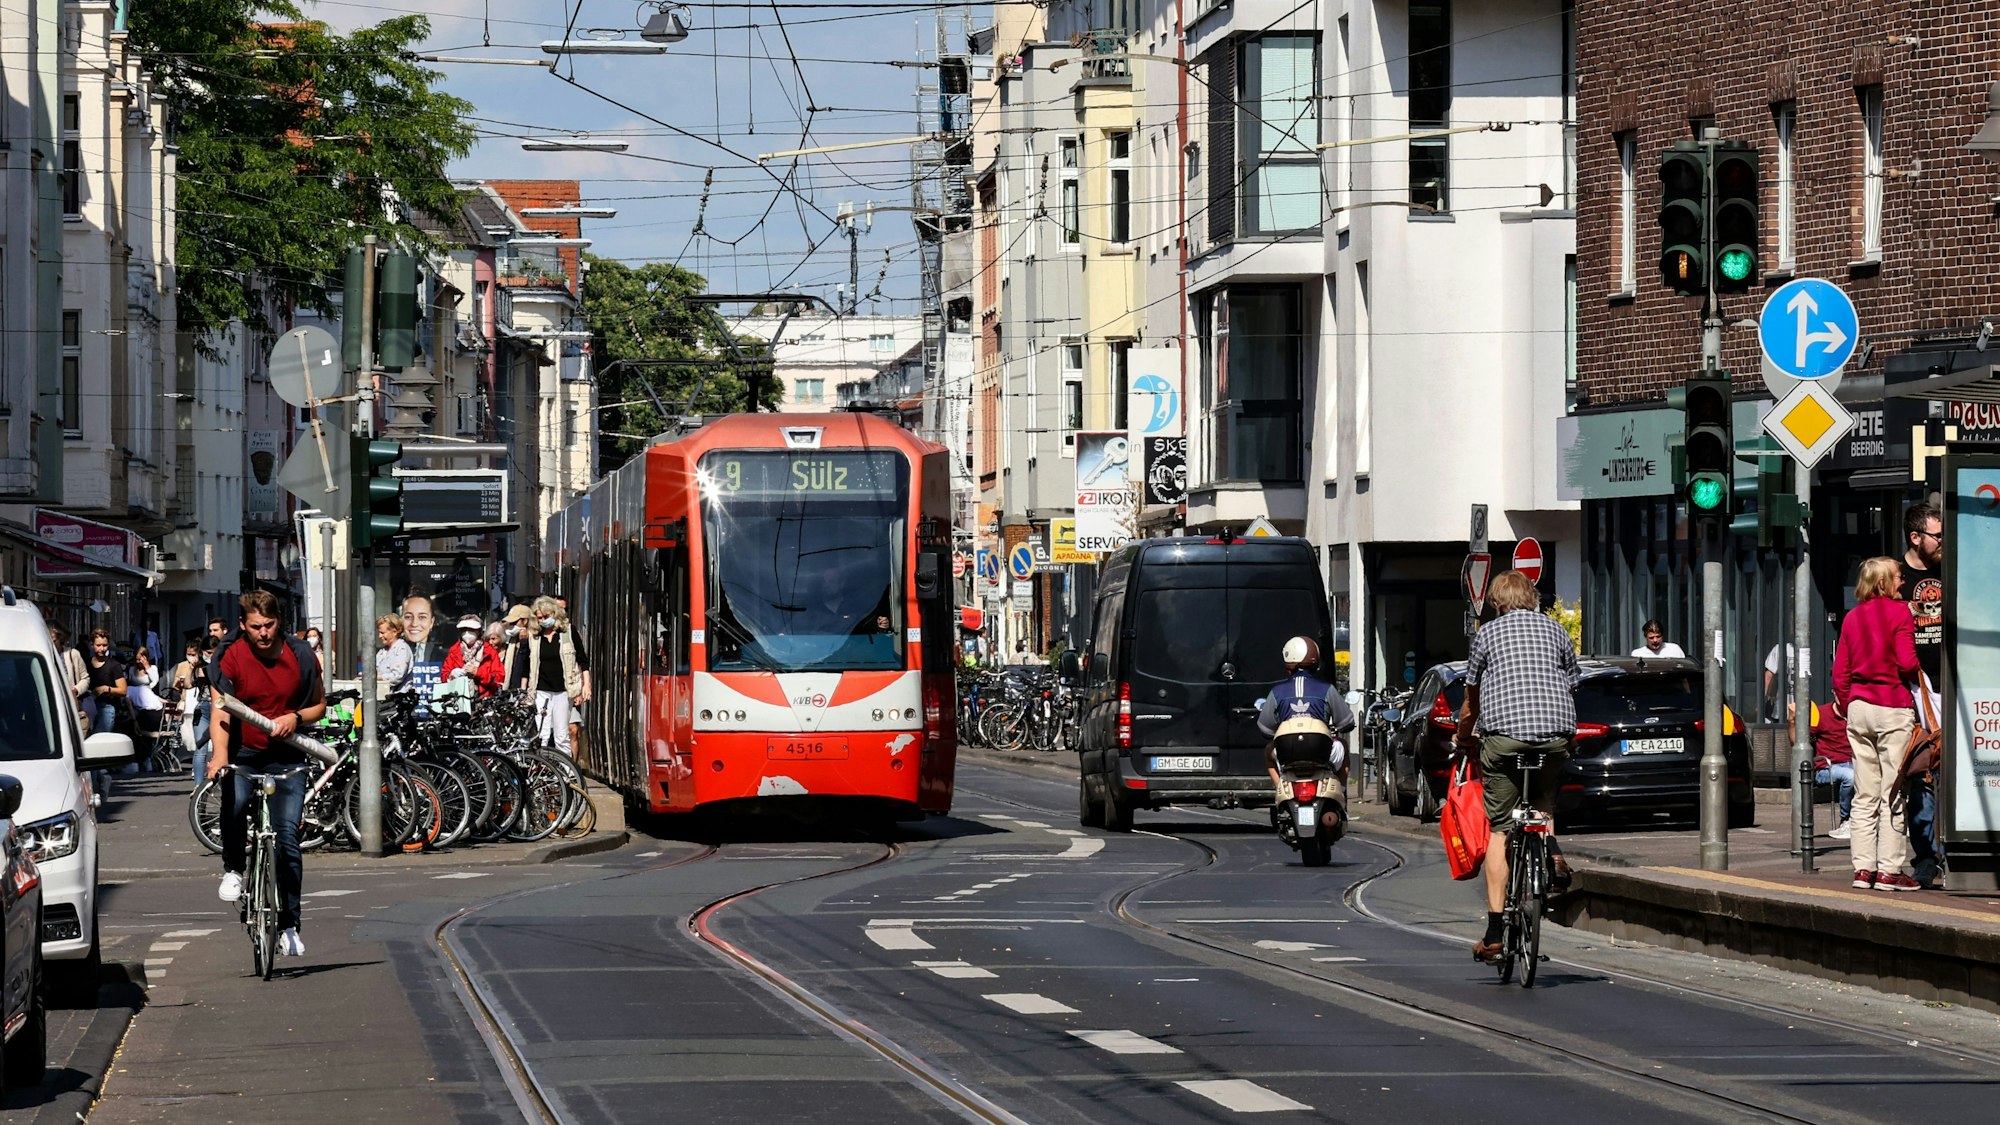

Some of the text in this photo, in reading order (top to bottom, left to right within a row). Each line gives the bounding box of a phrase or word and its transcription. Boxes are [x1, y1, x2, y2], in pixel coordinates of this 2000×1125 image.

[1851, 410, 1884, 437] PETE
[1153, 438, 1186, 452] SKE
[1850, 440, 1885, 457] BEERDIG
[726, 460, 849, 491] 9 Sülz
[793, 696, 812, 705] KVB
[786, 742, 823, 754] 4516
[1627, 739, 1683, 751] K EA 2110
[1157, 758, 1211, 769] GM GE 600
